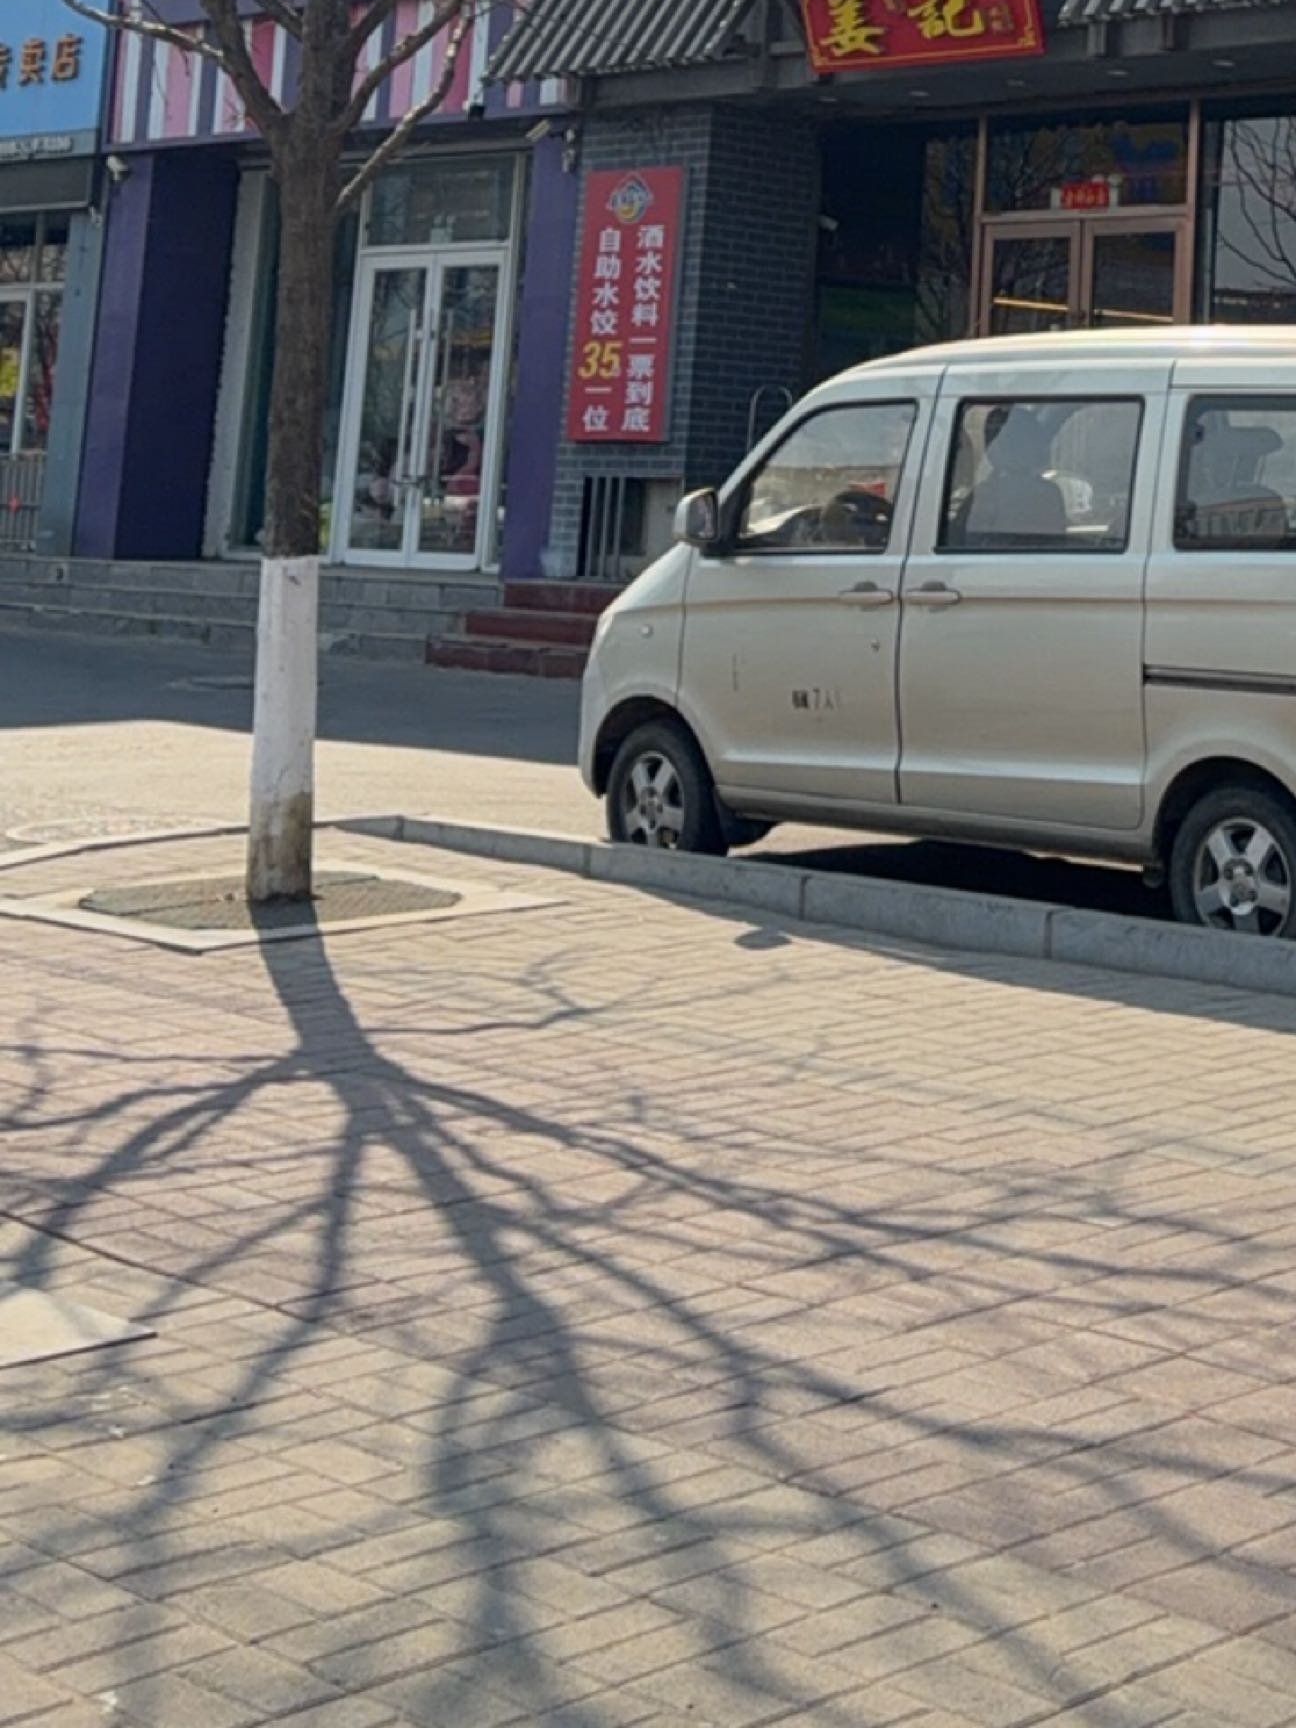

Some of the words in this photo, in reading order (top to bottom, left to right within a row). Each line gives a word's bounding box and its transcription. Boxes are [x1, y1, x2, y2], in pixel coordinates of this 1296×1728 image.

[621, 224, 665, 432] 酒水饮料一票到底
